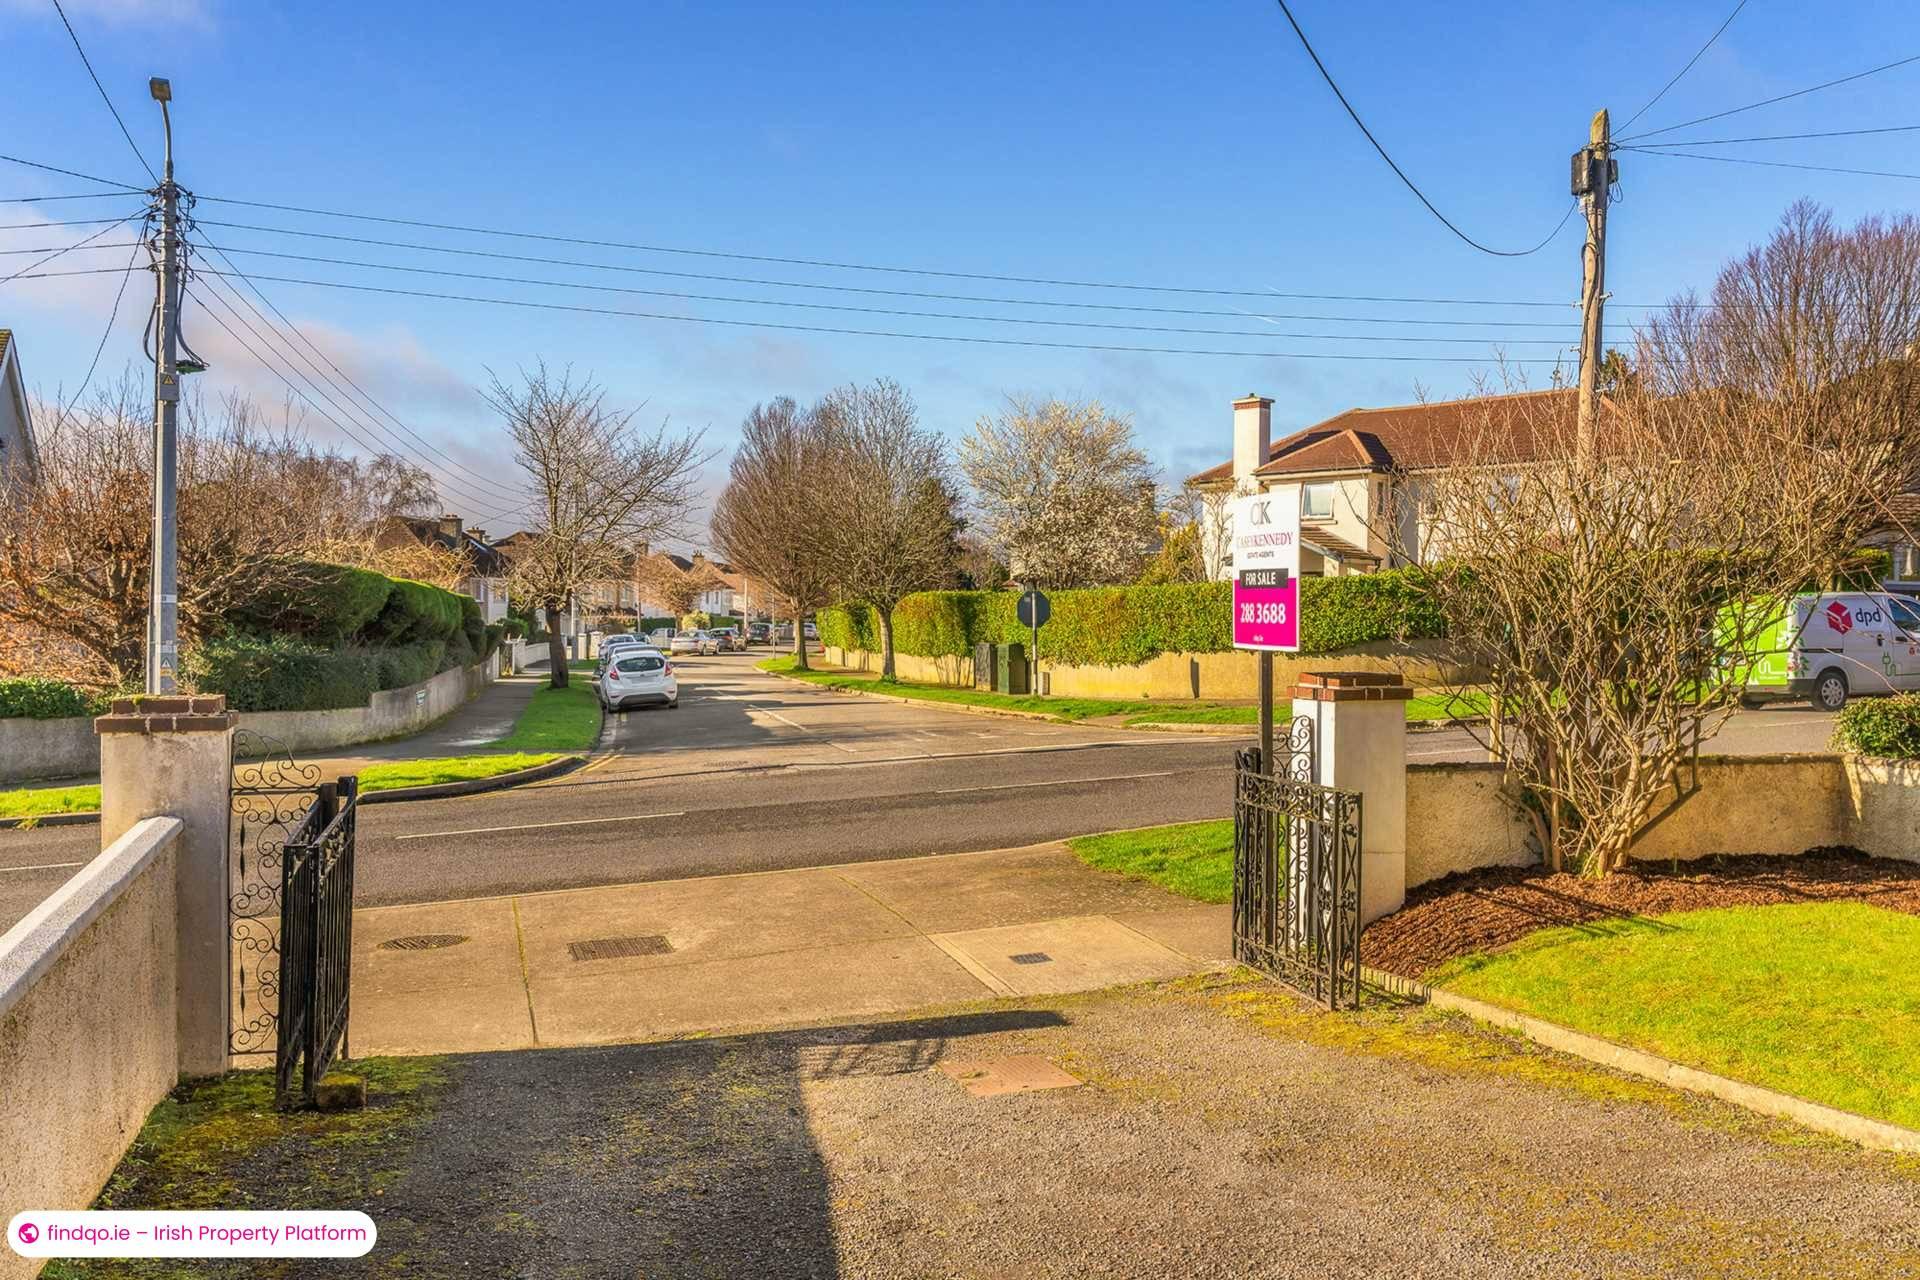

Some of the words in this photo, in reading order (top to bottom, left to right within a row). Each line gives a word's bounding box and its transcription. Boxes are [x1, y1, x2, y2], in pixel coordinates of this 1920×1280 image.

[1250, 501, 1271, 526] CK
[1245, 572, 1256, 585] FOR
[1257, 571, 1276, 585] SALE
[1240, 603, 1254, 624] 288
[1256, 603, 1286, 624] 3688
[1855, 607, 1882, 626] dpd
